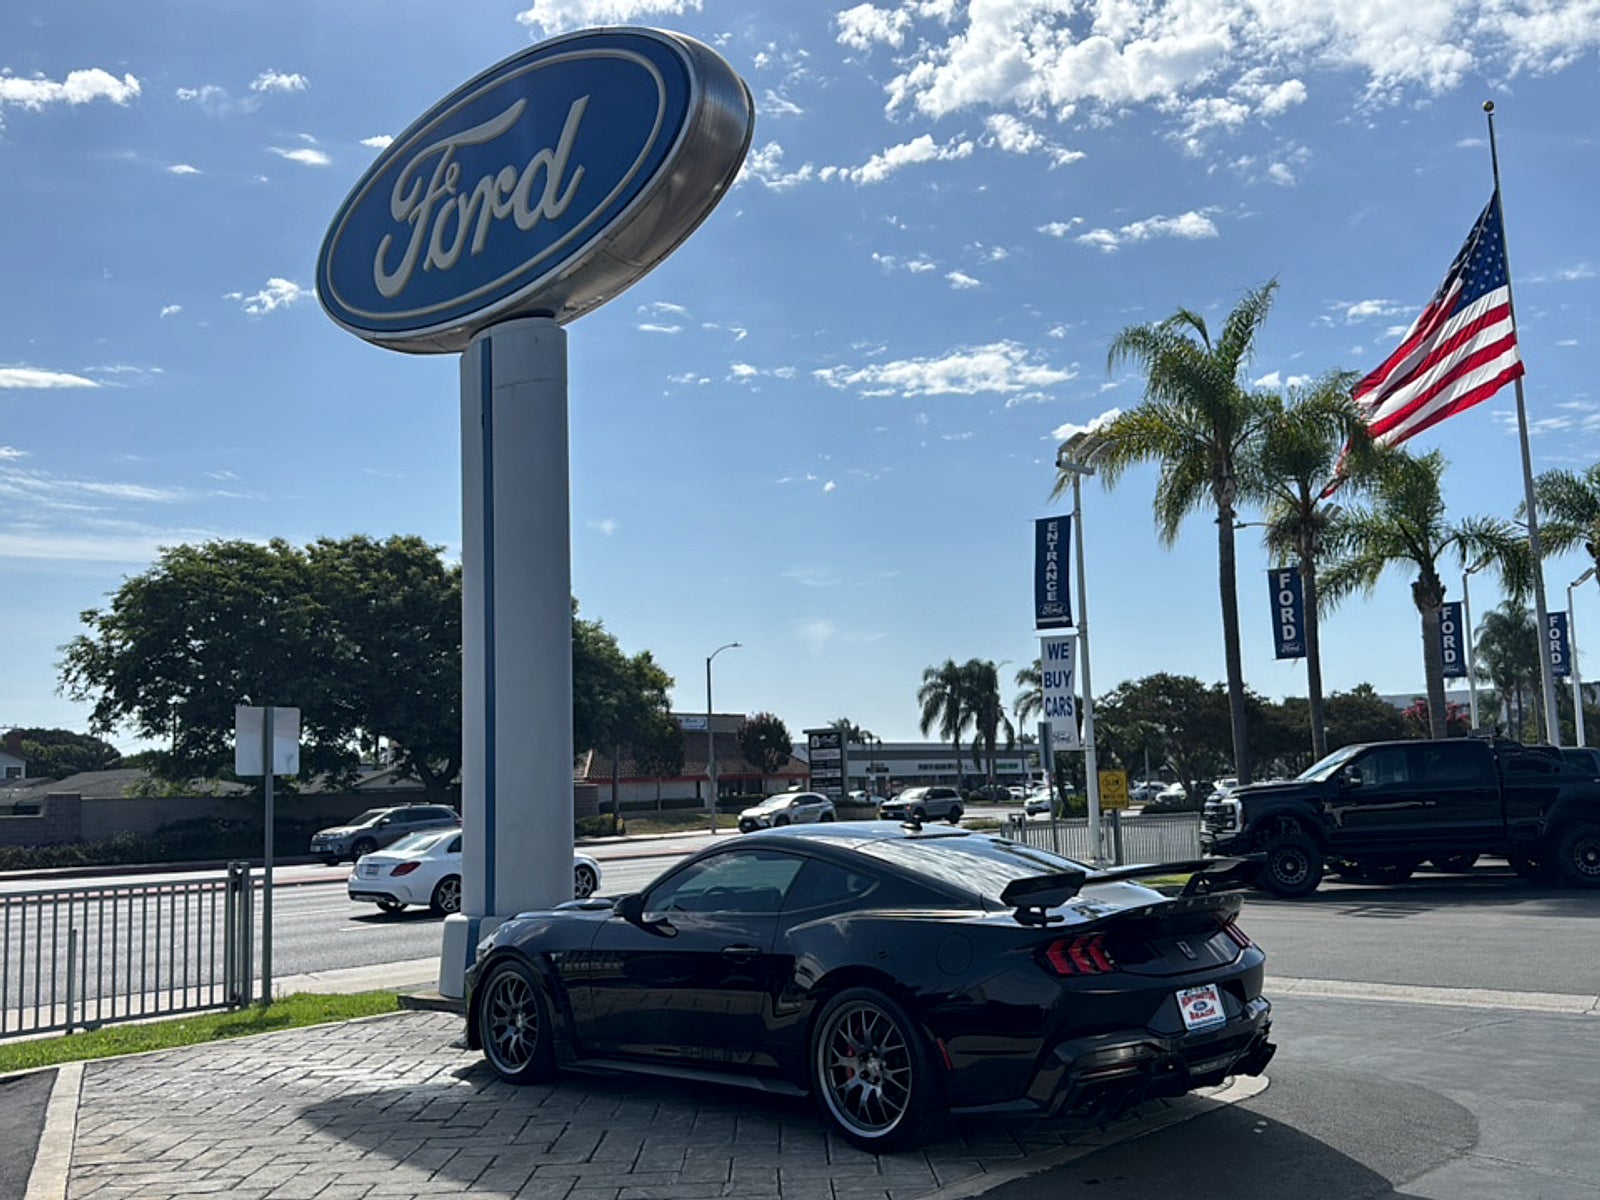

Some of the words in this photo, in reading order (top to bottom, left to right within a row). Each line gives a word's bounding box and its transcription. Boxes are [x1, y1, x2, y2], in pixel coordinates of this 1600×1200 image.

[373, 94, 590, 298] Ford
[1045, 521, 1059, 602] ENTRANCE
[1278, 573, 1297, 641] FORD
[1047, 642, 1070, 660] WE
[1441, 606, 1457, 663] FORD
[1549, 615, 1562, 665] FORD
[1044, 670, 1072, 689] BUY
[1045, 695, 1073, 717] CARS
